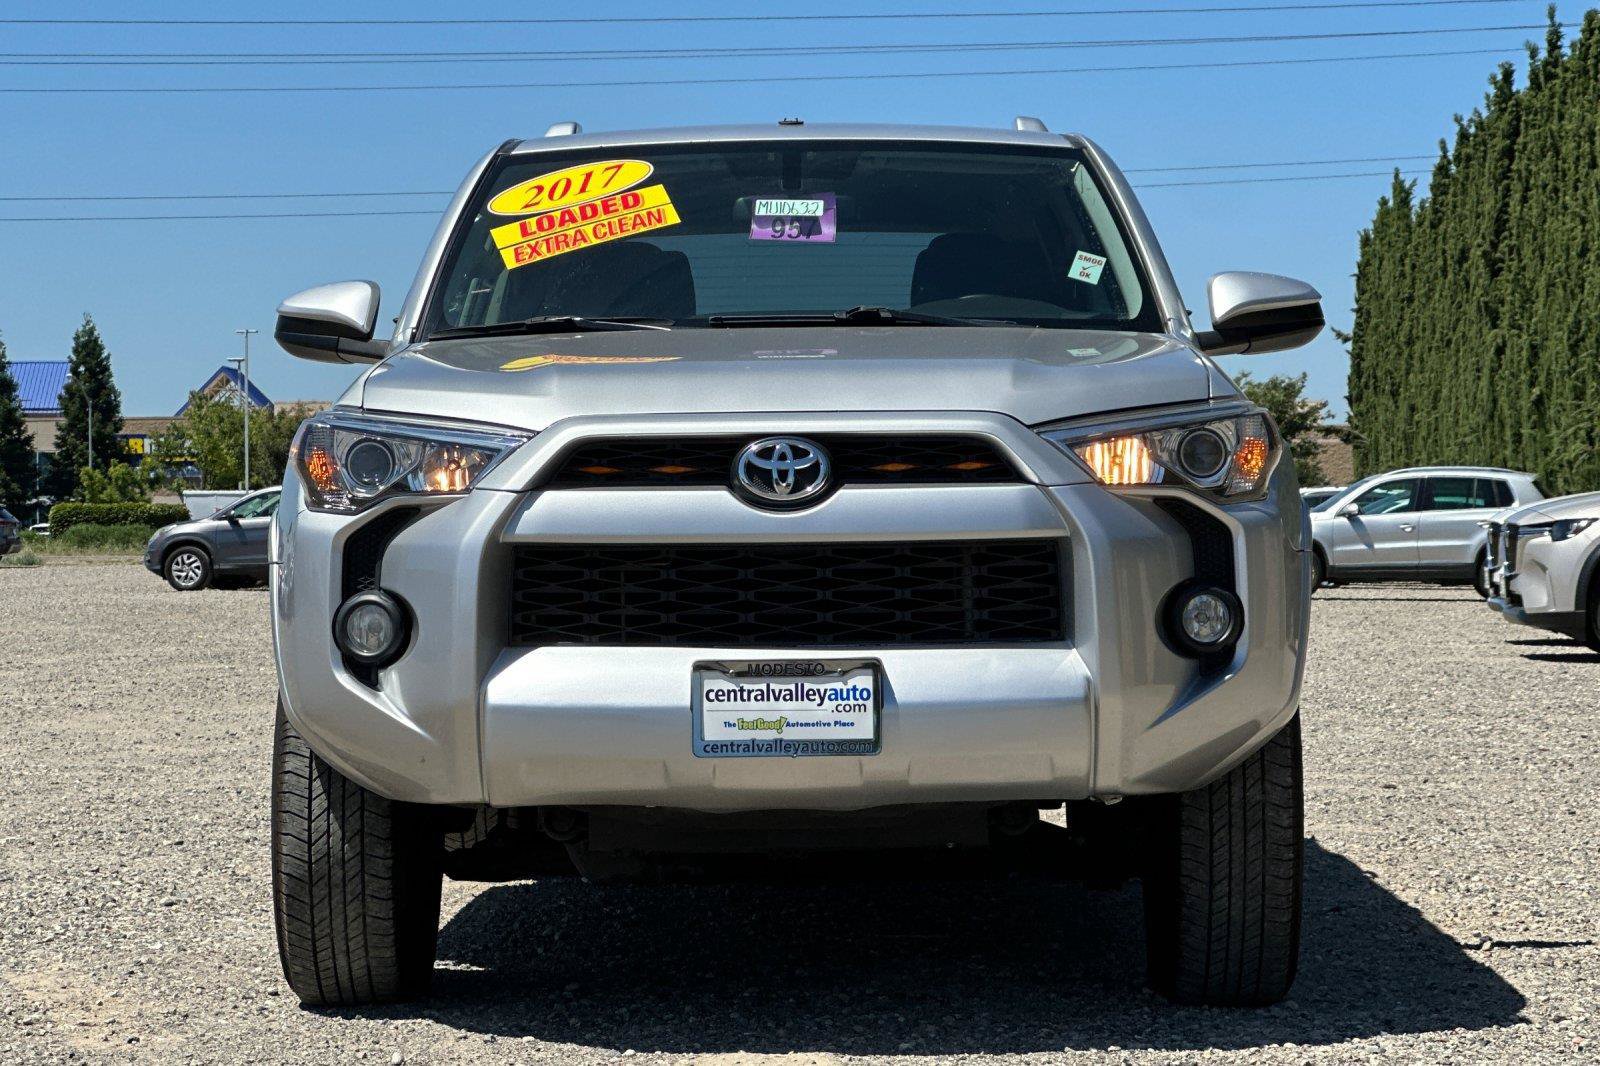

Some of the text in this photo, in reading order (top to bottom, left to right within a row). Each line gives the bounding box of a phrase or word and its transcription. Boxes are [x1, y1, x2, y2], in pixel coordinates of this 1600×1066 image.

[520, 163, 625, 210] 2017
[518, 192, 645, 239] LOADED
[513, 208, 667, 265] EXTRA CLEAN
[1078, 255, 1103, 265] SMOG
[747, 662, 825, 677] MODESTO
[705, 683, 872, 707] centralvalleyauto
[831, 702, 867, 713] .com
[723, 720, 737, 728] The
[785, 720, 832, 729] Automotive
[833, 720, 855, 728] Place
[703, 738, 874, 755] centralvalleyauto.com
